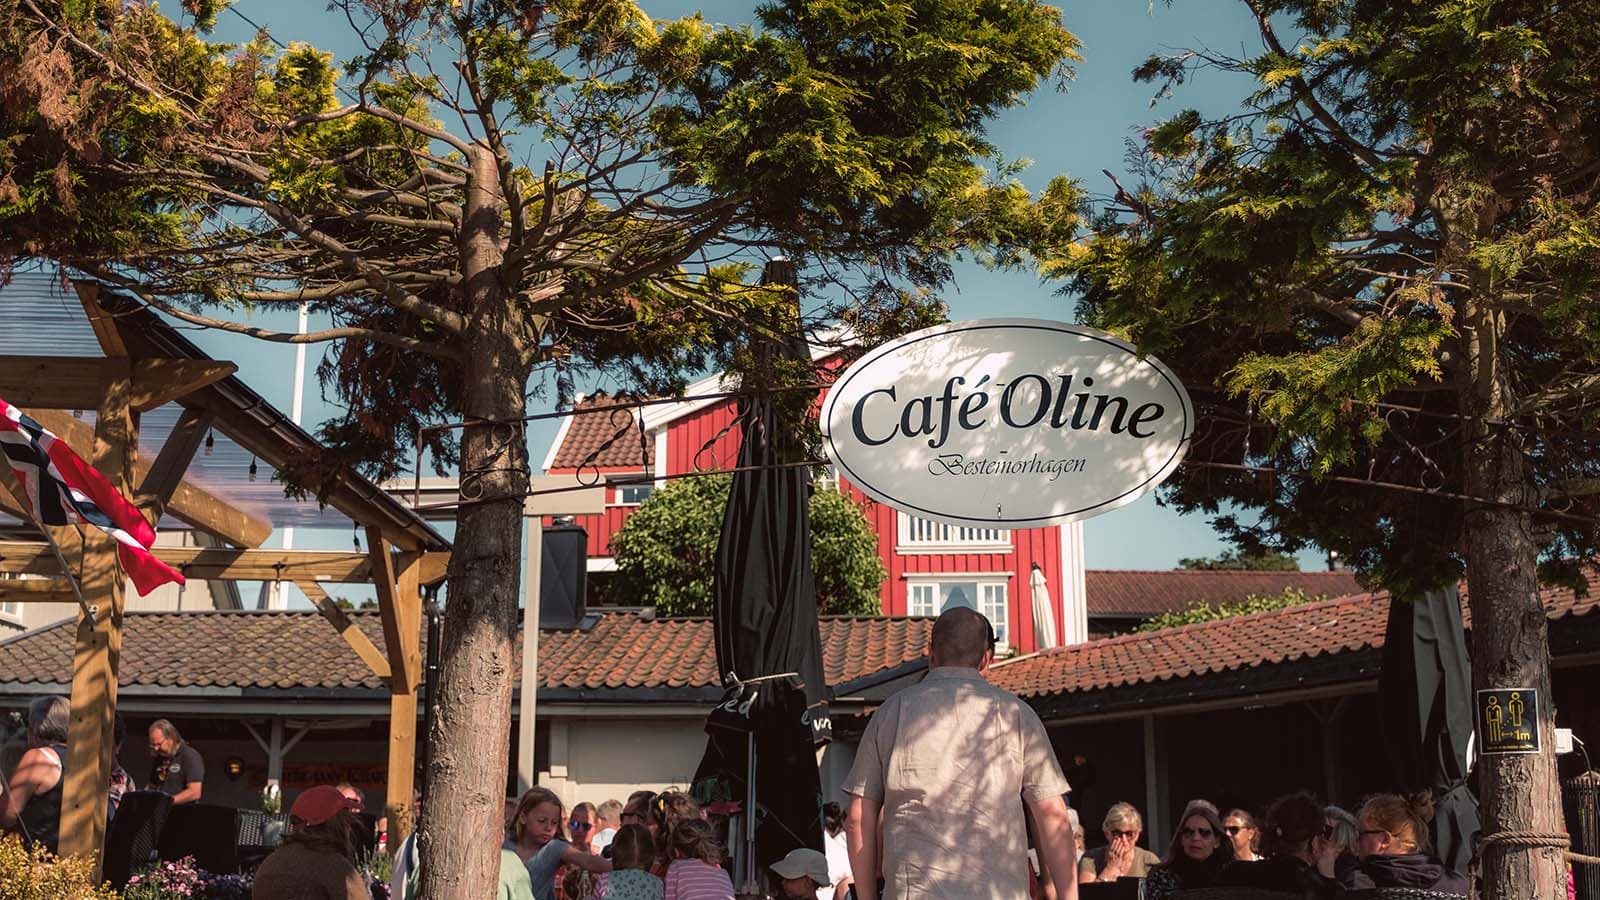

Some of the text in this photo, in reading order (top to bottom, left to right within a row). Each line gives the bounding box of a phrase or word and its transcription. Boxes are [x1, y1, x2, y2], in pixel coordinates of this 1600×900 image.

[851, 374, 1165, 449] Café Oline
[927, 453, 1086, 482] Bestemorhagen
[1514, 729, 1530, 741] 1m
